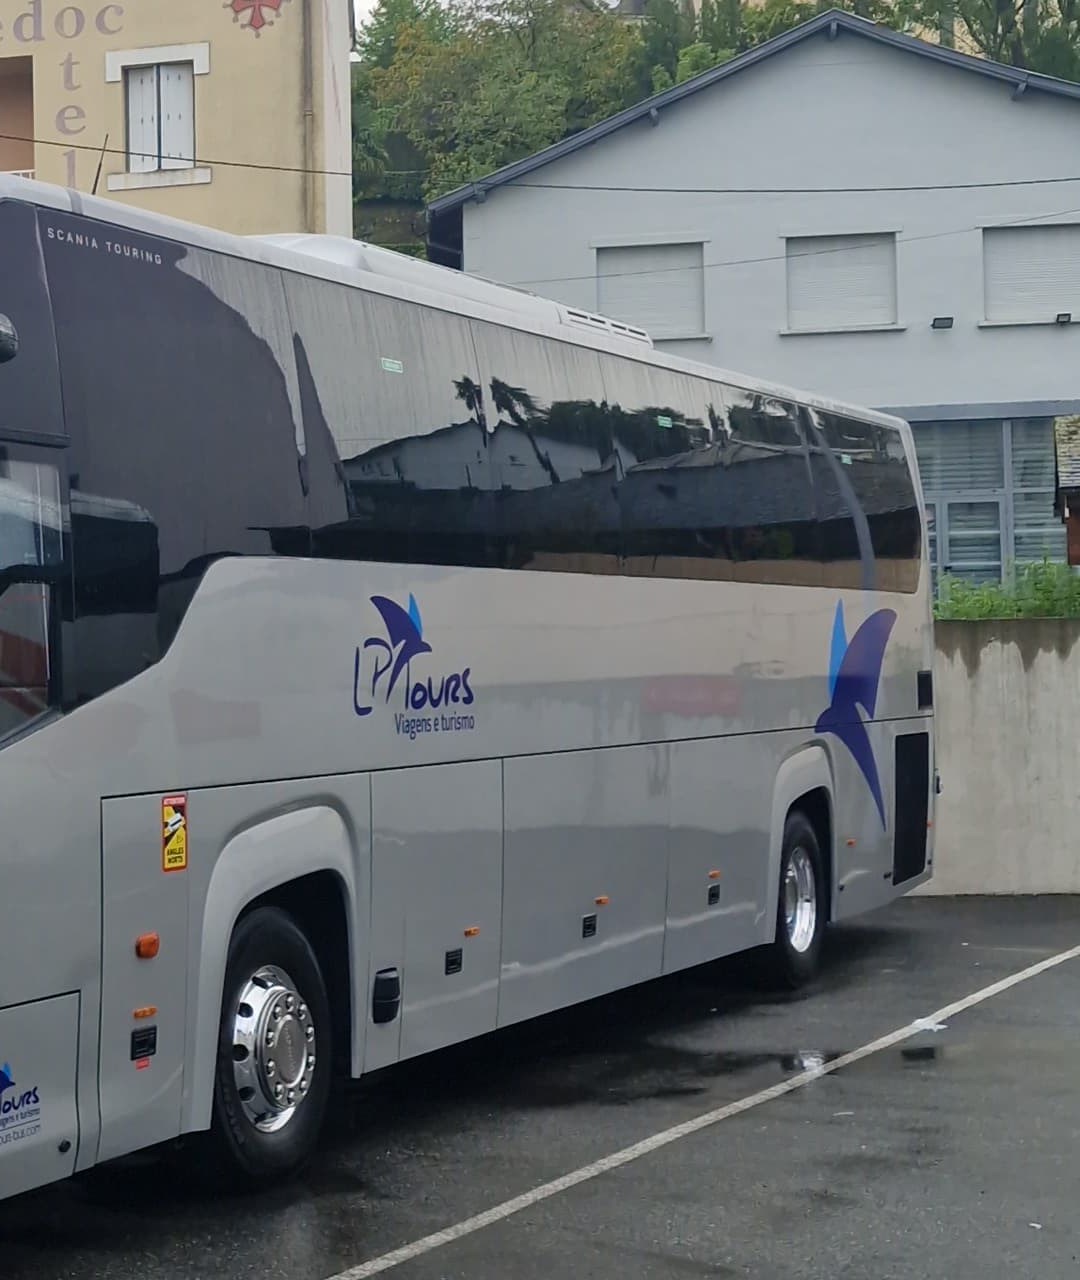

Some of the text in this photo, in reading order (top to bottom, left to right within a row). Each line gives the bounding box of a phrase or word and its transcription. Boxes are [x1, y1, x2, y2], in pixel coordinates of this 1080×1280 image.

[47, 227, 162, 265] SCANIA TOURING
[394, 711, 475, 740] Viagens e turismo
